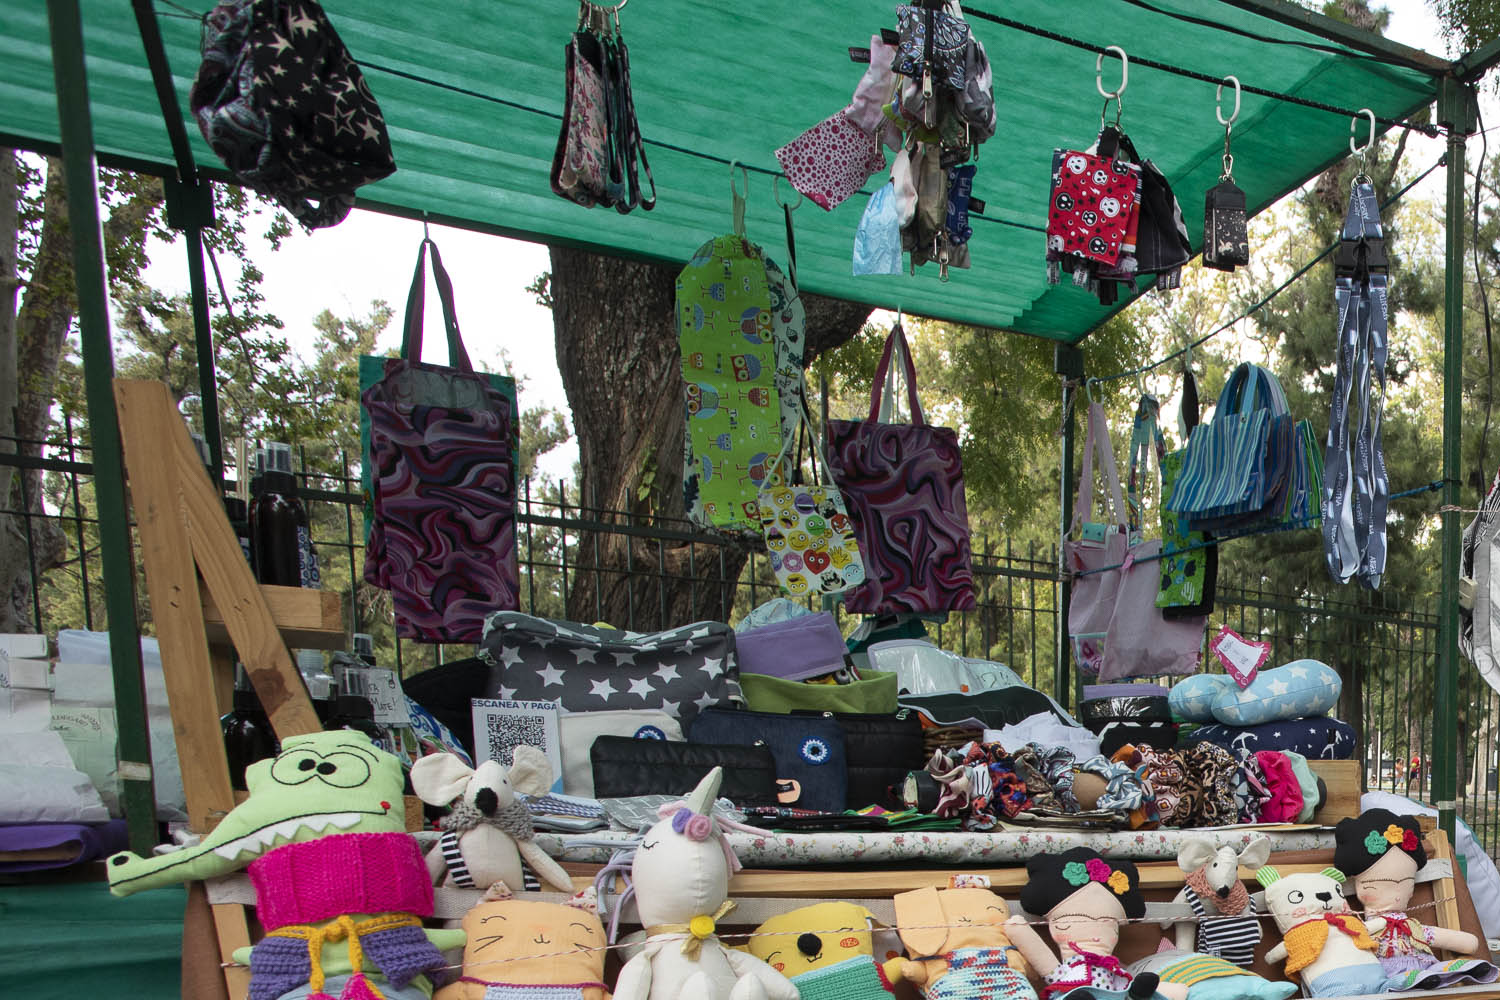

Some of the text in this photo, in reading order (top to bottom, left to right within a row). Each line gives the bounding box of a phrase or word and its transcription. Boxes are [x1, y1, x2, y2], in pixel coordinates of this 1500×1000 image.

[472, 700, 557, 710] ESCANEA Y PAGA
